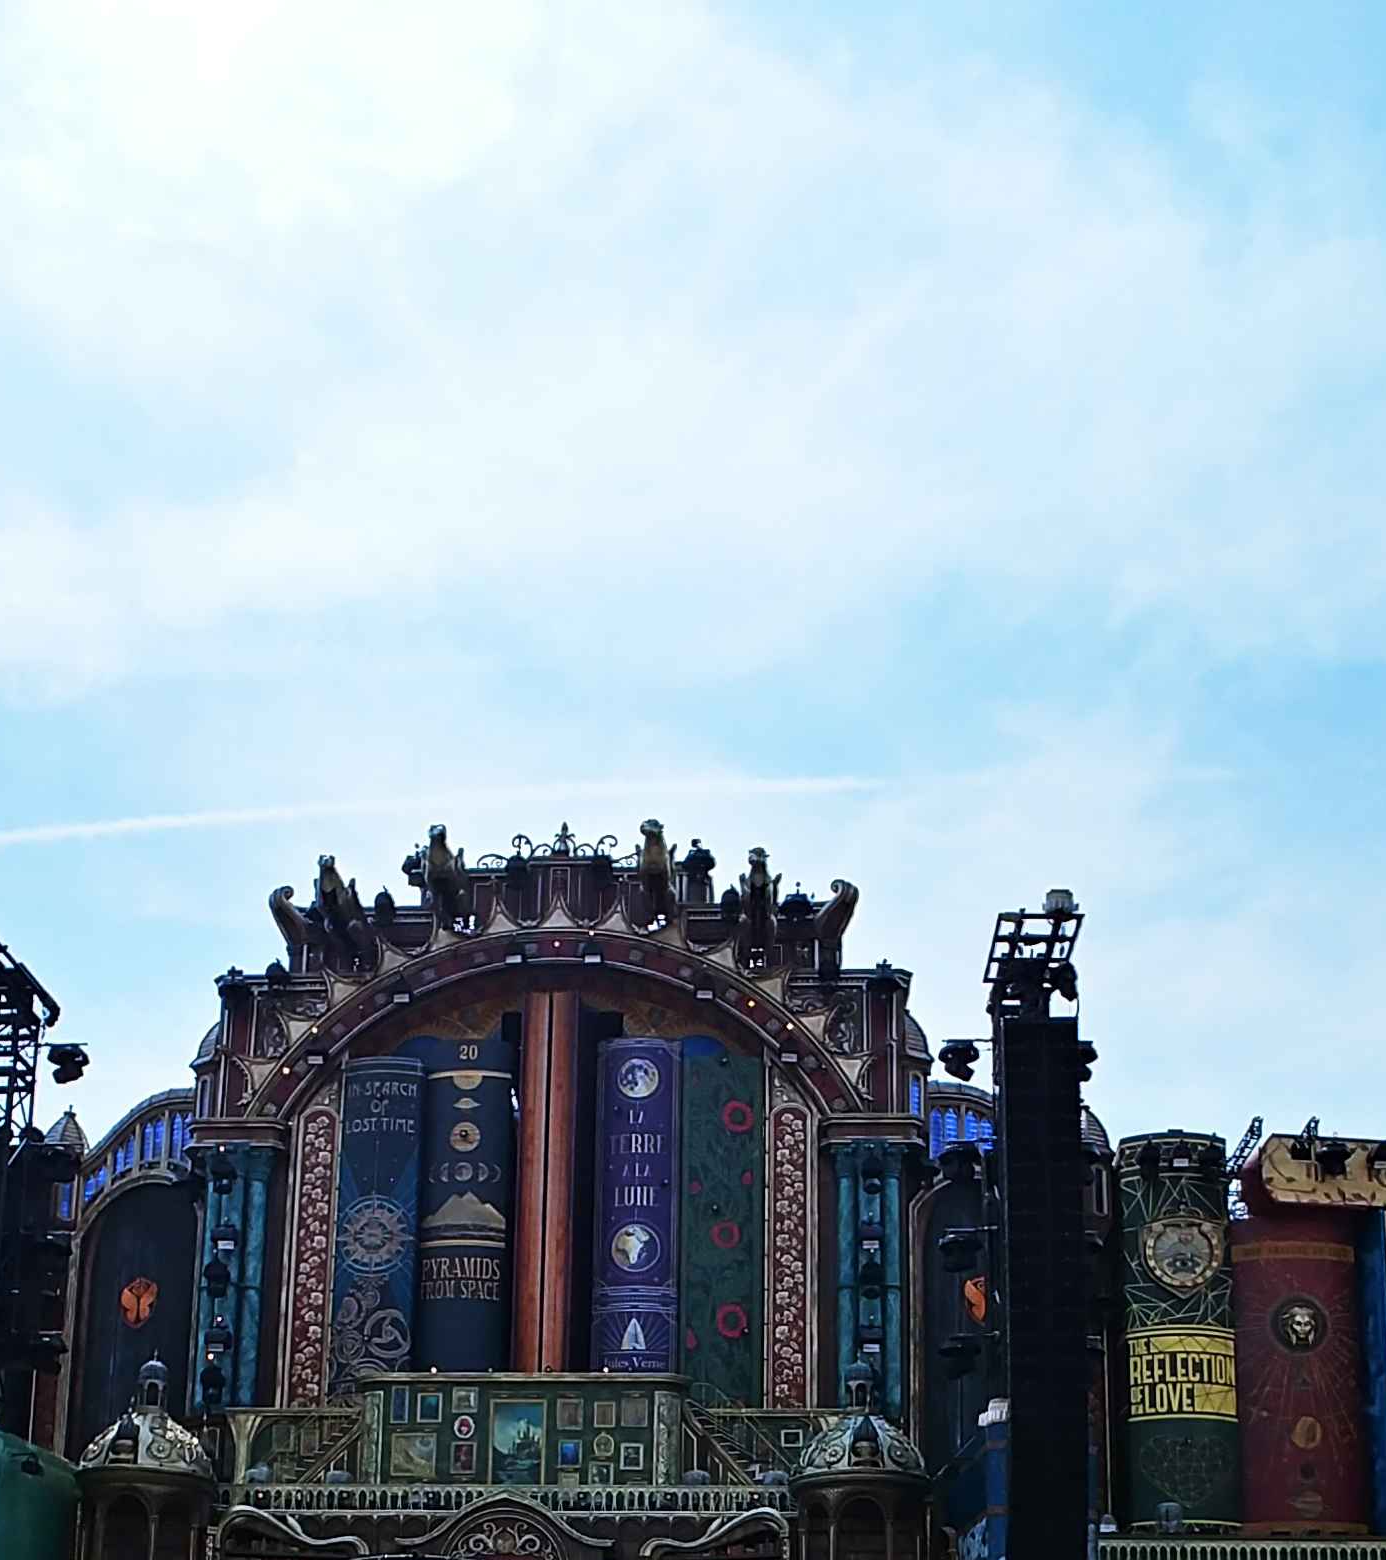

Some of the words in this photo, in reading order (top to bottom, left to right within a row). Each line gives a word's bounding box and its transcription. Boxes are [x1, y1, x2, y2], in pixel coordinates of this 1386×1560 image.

[458, 1044, 479, 1060] 20
[347, 1083, 360, 1098] IN
[364, 1081, 419, 1098] SEARCH
[344, 1117, 377, 1134] LOST
[377, 1117, 416, 1134] TIME
[609, 1132, 666, 1155] TERRE
[614, 1185, 662, 1208] LUNE
[421, 1256, 501, 1280] PYRAMIDS
[420, 1279, 455, 1300] FROM
[460, 1279, 501, 1301] SPACE
[1127, 1338, 1149, 1356] THE
[632, 1356, 667, 1369] Verne
[1129, 1352, 1236, 1386] REFLECTION
[1143, 1382, 1193, 1414] LOVE
